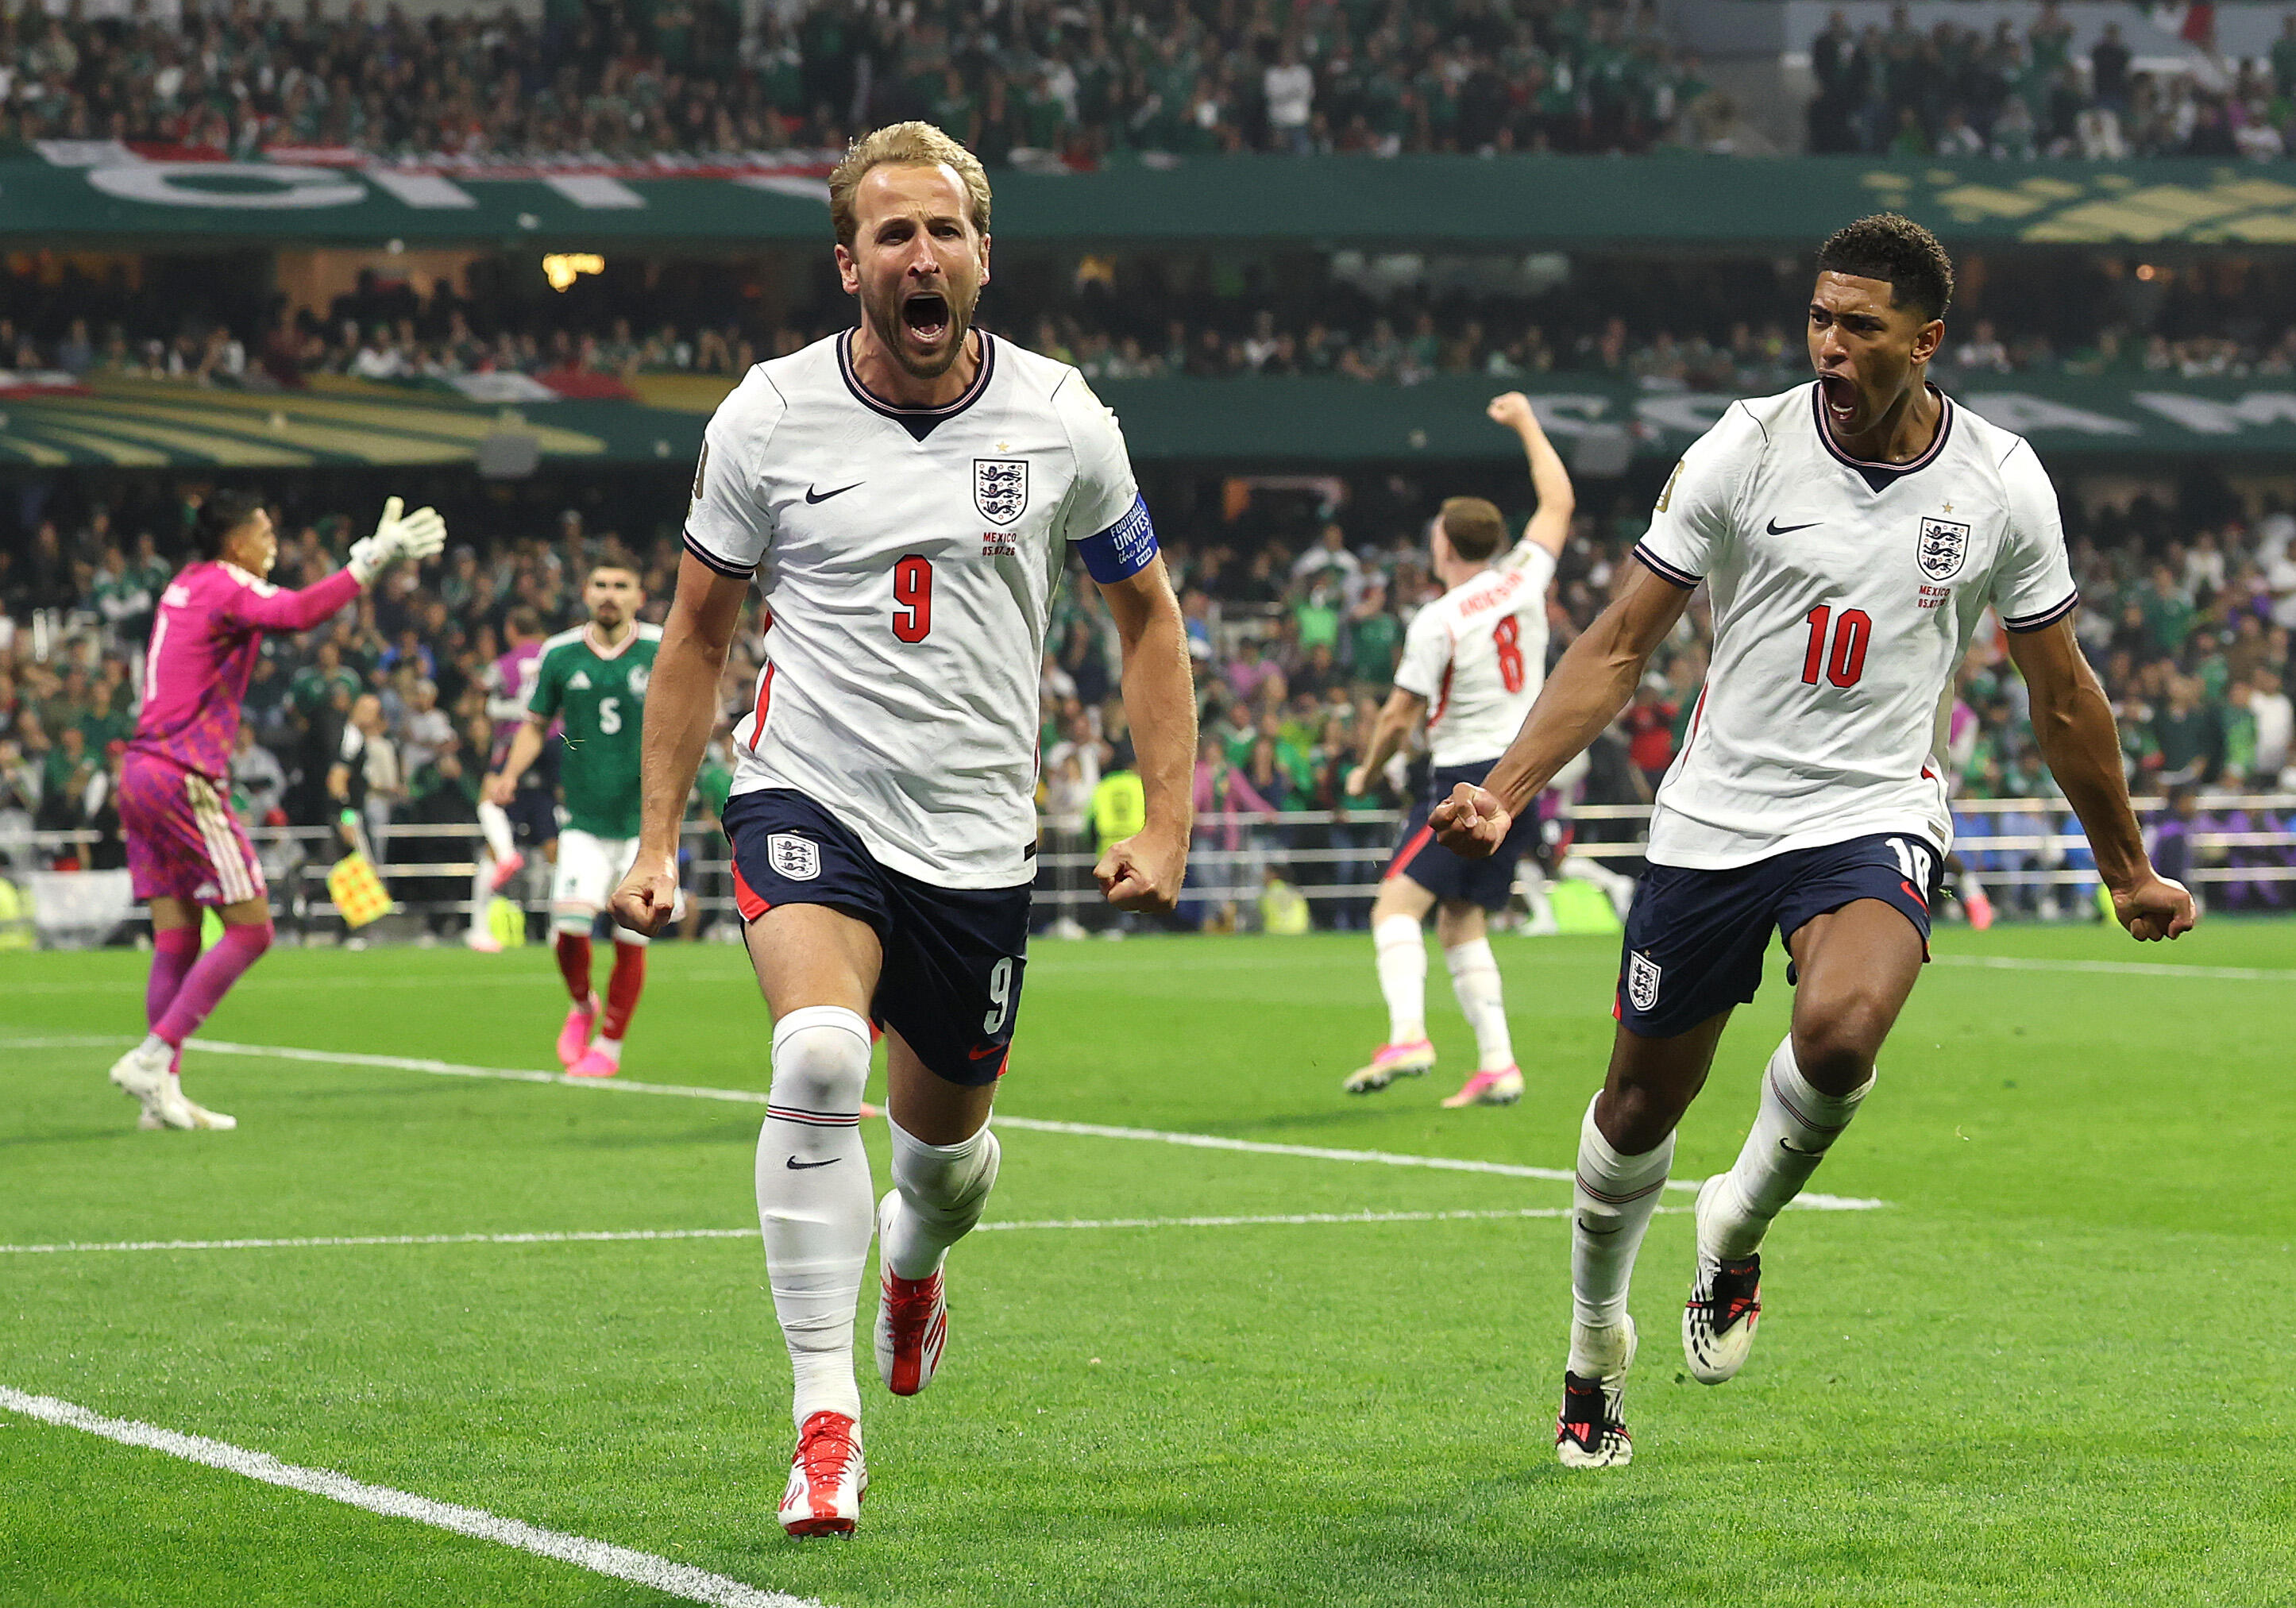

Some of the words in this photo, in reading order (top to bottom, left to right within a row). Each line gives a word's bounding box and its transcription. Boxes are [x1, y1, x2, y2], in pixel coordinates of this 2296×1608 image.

[983, 532, 1017, 543] MEXICO
[1110, 502, 1144, 537] FOOTBALL
[1113, 511, 1149, 550] UNITES
[982, 546, 1016, 556] 05.07.26
[1118, 549, 1136, 564] the
[892, 554, 932, 643] 9
[1919, 584, 1951, 596] MEXICO
[146, 611, 169, 701] 1
[1493, 615, 1524, 693] 8
[1801, 604, 1872, 688] 10
[599, 696, 622, 735] 5
[1885, 837, 1931, 905] 10
[983, 957, 1013, 1035] 9
